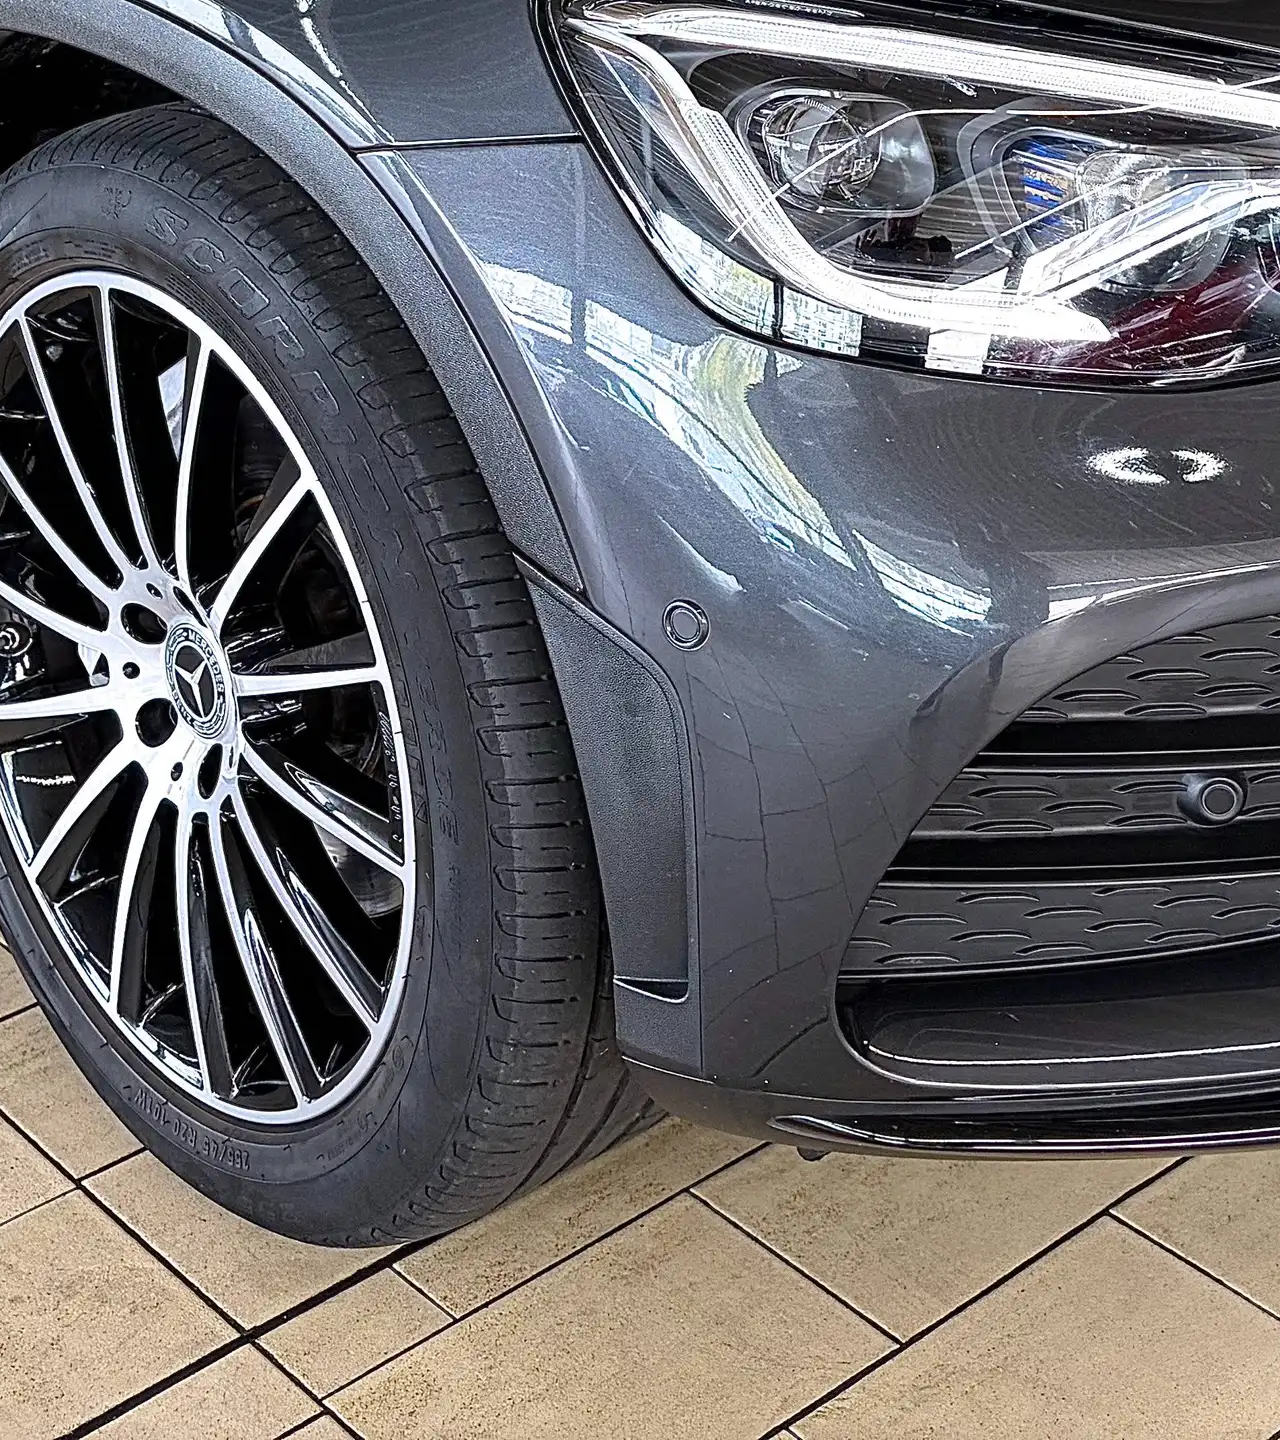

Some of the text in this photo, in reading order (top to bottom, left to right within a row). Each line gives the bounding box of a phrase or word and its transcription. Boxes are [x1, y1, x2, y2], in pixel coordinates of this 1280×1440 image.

[188, 629, 225, 692] MERCEDES
[134, 1088, 169, 1123] 101W
[172, 1118, 197, 1148] R20
